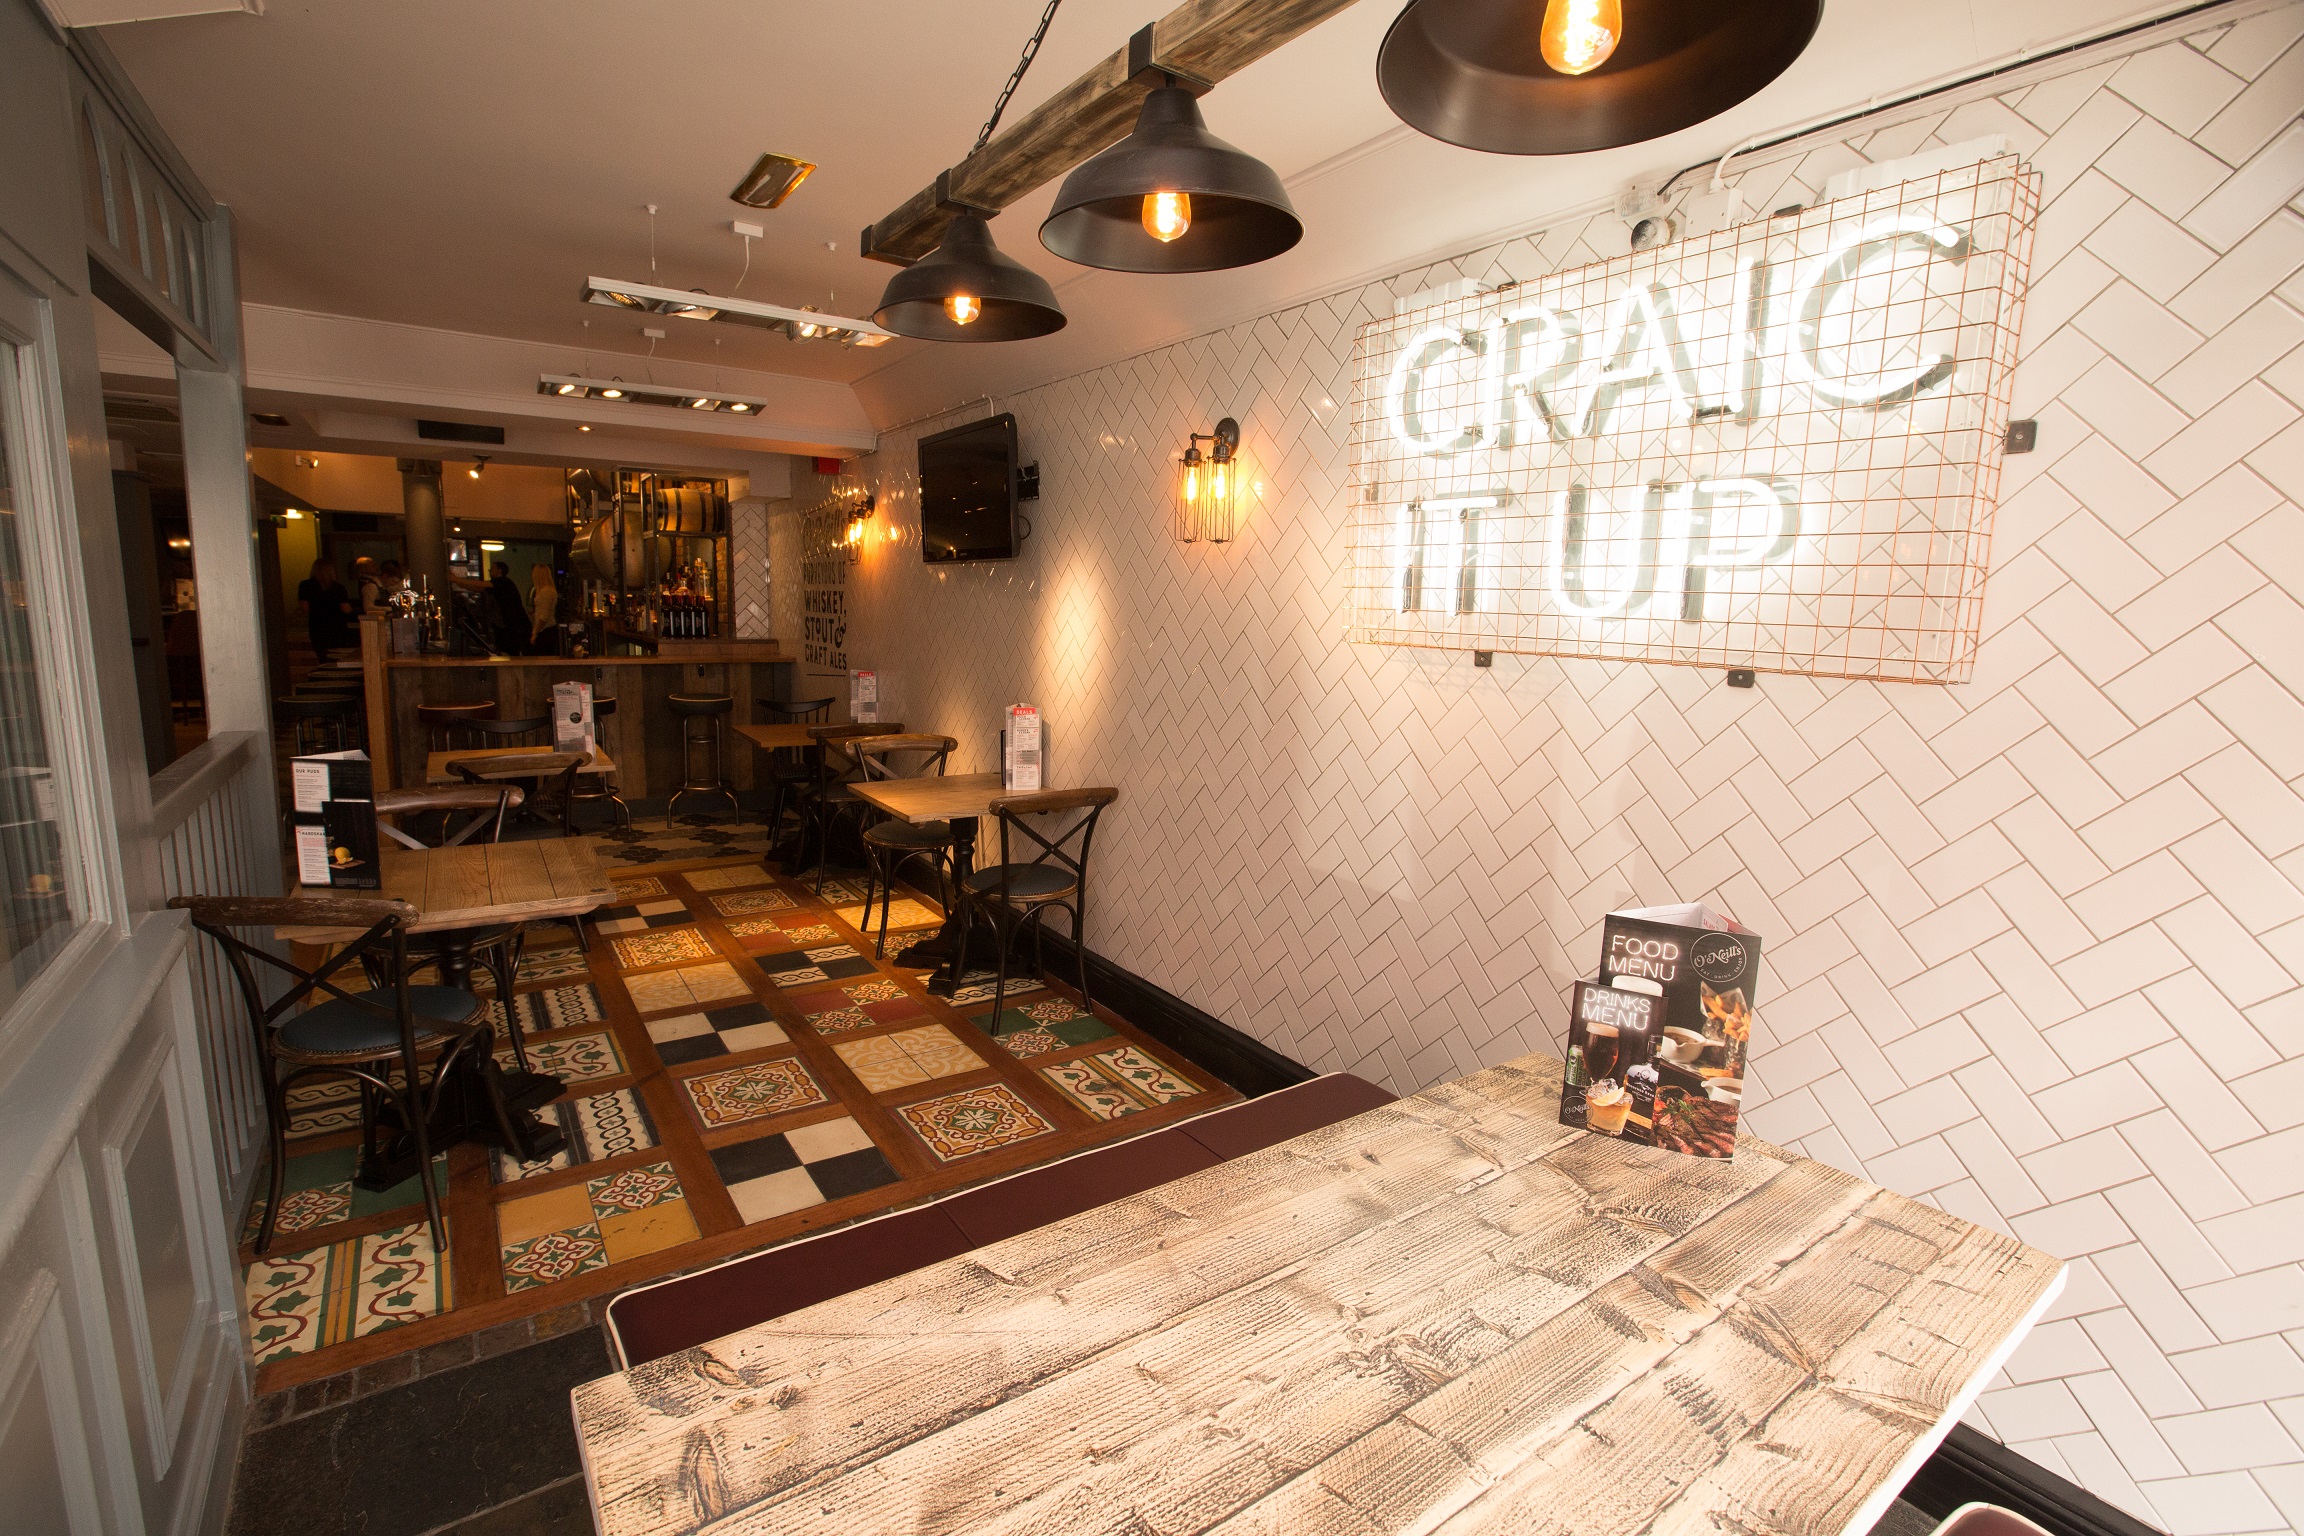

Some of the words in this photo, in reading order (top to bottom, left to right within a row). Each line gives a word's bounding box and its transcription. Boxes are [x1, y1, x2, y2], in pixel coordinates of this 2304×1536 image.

[1386, 213, 1966, 452] CRAIC
[1395, 494, 1500, 617] IT
[1549, 477, 1788, 622] UP
[838, 560, 846, 584] OF
[804, 590, 847, 617] WHISKEY,
[804, 615, 834, 645] STOUT
[804, 643, 827, 666] CRAFT
[829, 650, 847, 670] ALES
[1611, 934, 1679, 960] FOOD
[1693, 945, 1742, 968] O'Neill's
[1608, 954, 1676, 981] MENU
[1584, 987, 1651, 1013] DRINKS
[1581, 1002, 1649, 1031] MENU
